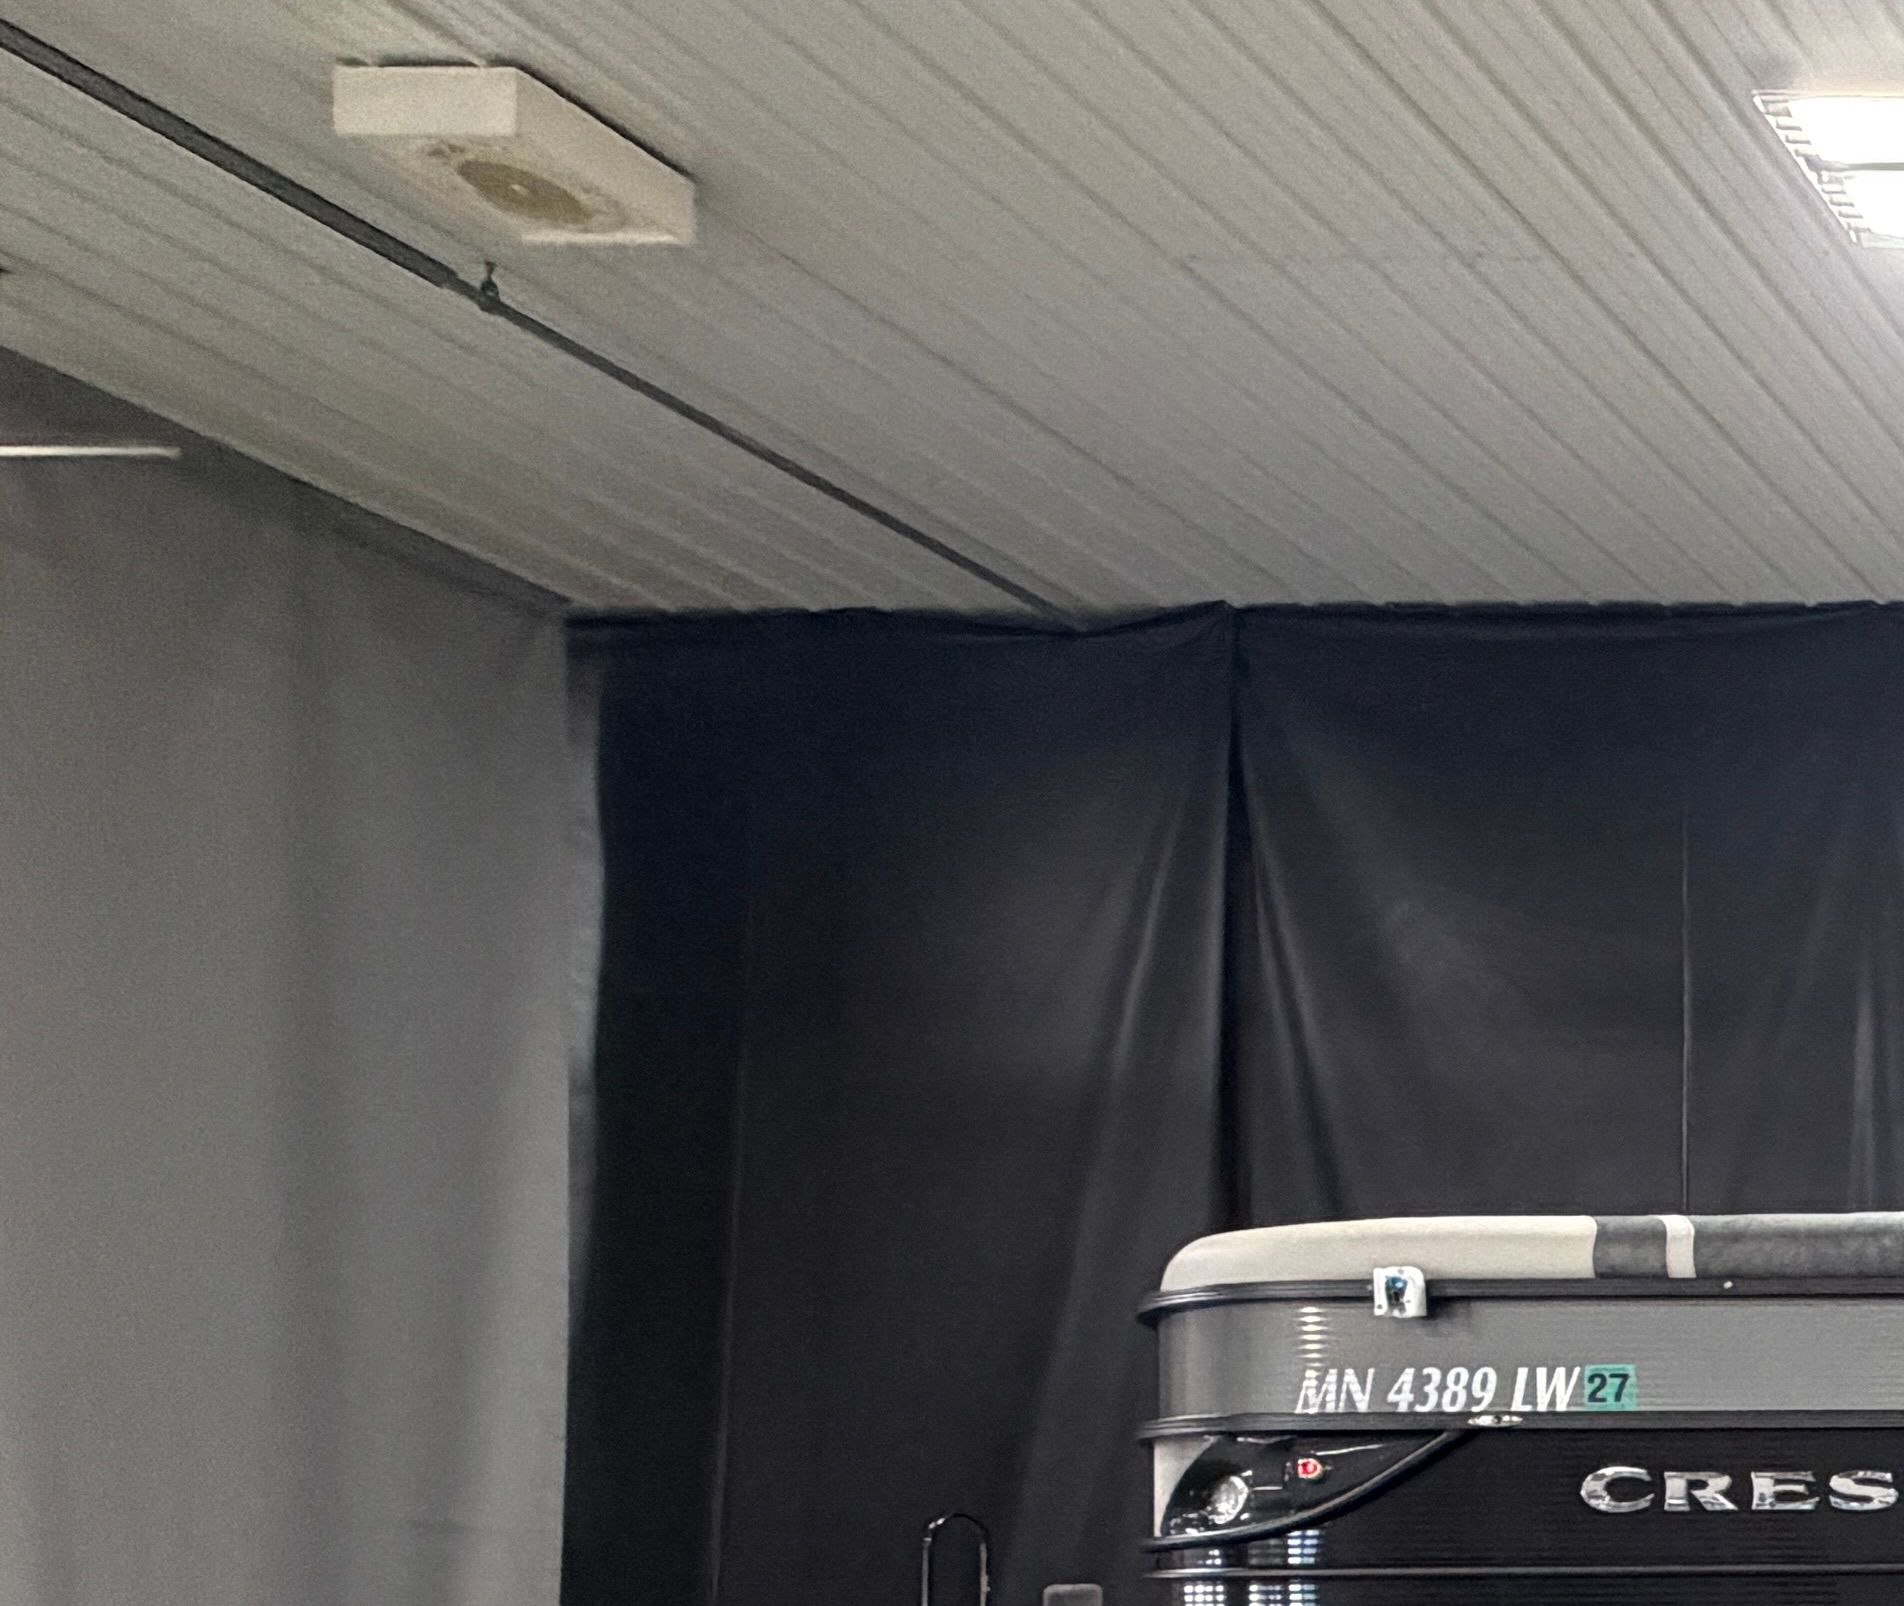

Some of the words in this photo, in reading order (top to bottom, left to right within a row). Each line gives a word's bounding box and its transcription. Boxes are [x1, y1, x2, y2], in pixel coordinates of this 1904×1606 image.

[1295, 1367, 1375, 1414] MN
[1387, 1366, 1498, 1413] 4389
[1511, 1366, 1581, 1412] LW
[1586, 1372, 1630, 1403] 27
